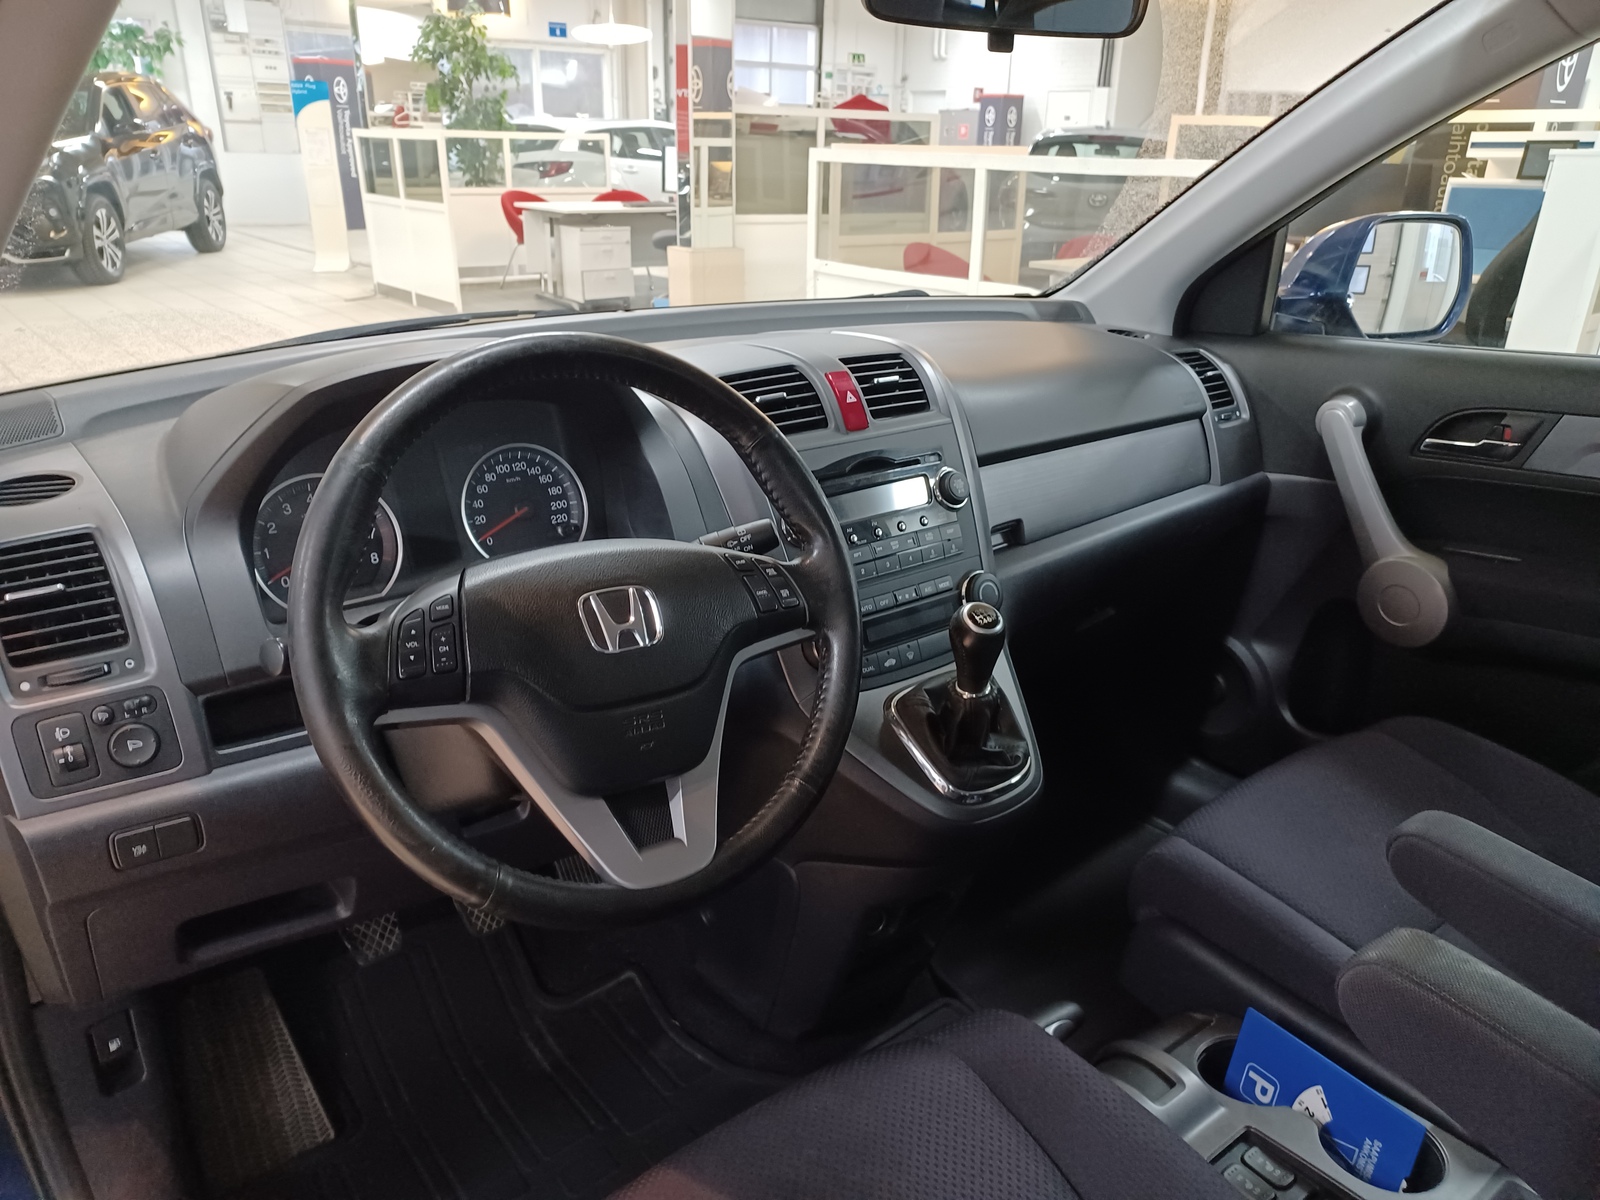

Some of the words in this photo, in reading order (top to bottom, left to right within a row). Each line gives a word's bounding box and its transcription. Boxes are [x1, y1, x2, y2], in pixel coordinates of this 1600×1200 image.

[495, 464, 510, 474] 100
[512, 461, 527, 471] 120
[527, 466, 541, 476] 140
[485, 473, 497, 482] 80
[539, 474, 553, 484] 160
[476, 484, 489, 494] 60
[548, 486, 563, 496] 180
[282, 503, 292, 515] 3
[473, 500, 484, 509] 40
[551, 500, 567, 511] 200
[474, 515, 486, 525] 20
[551, 513, 568, 524] 220
[267, 522, 278, 534] 2
[486, 537, 493, 546] 0
[740, 533, 752, 544] OFF
[743, 544, 754, 552] ON
[264, 547, 269, 560] 1
[370, 552, 379, 564] 8
[281, 575, 290, 588] 0
[405, 641, 421, 649] VOL
[438, 645, 450, 654] CH
[1248, 1070, 1275, 1104] P
[1304, 1106, 1315, 1118] 2
